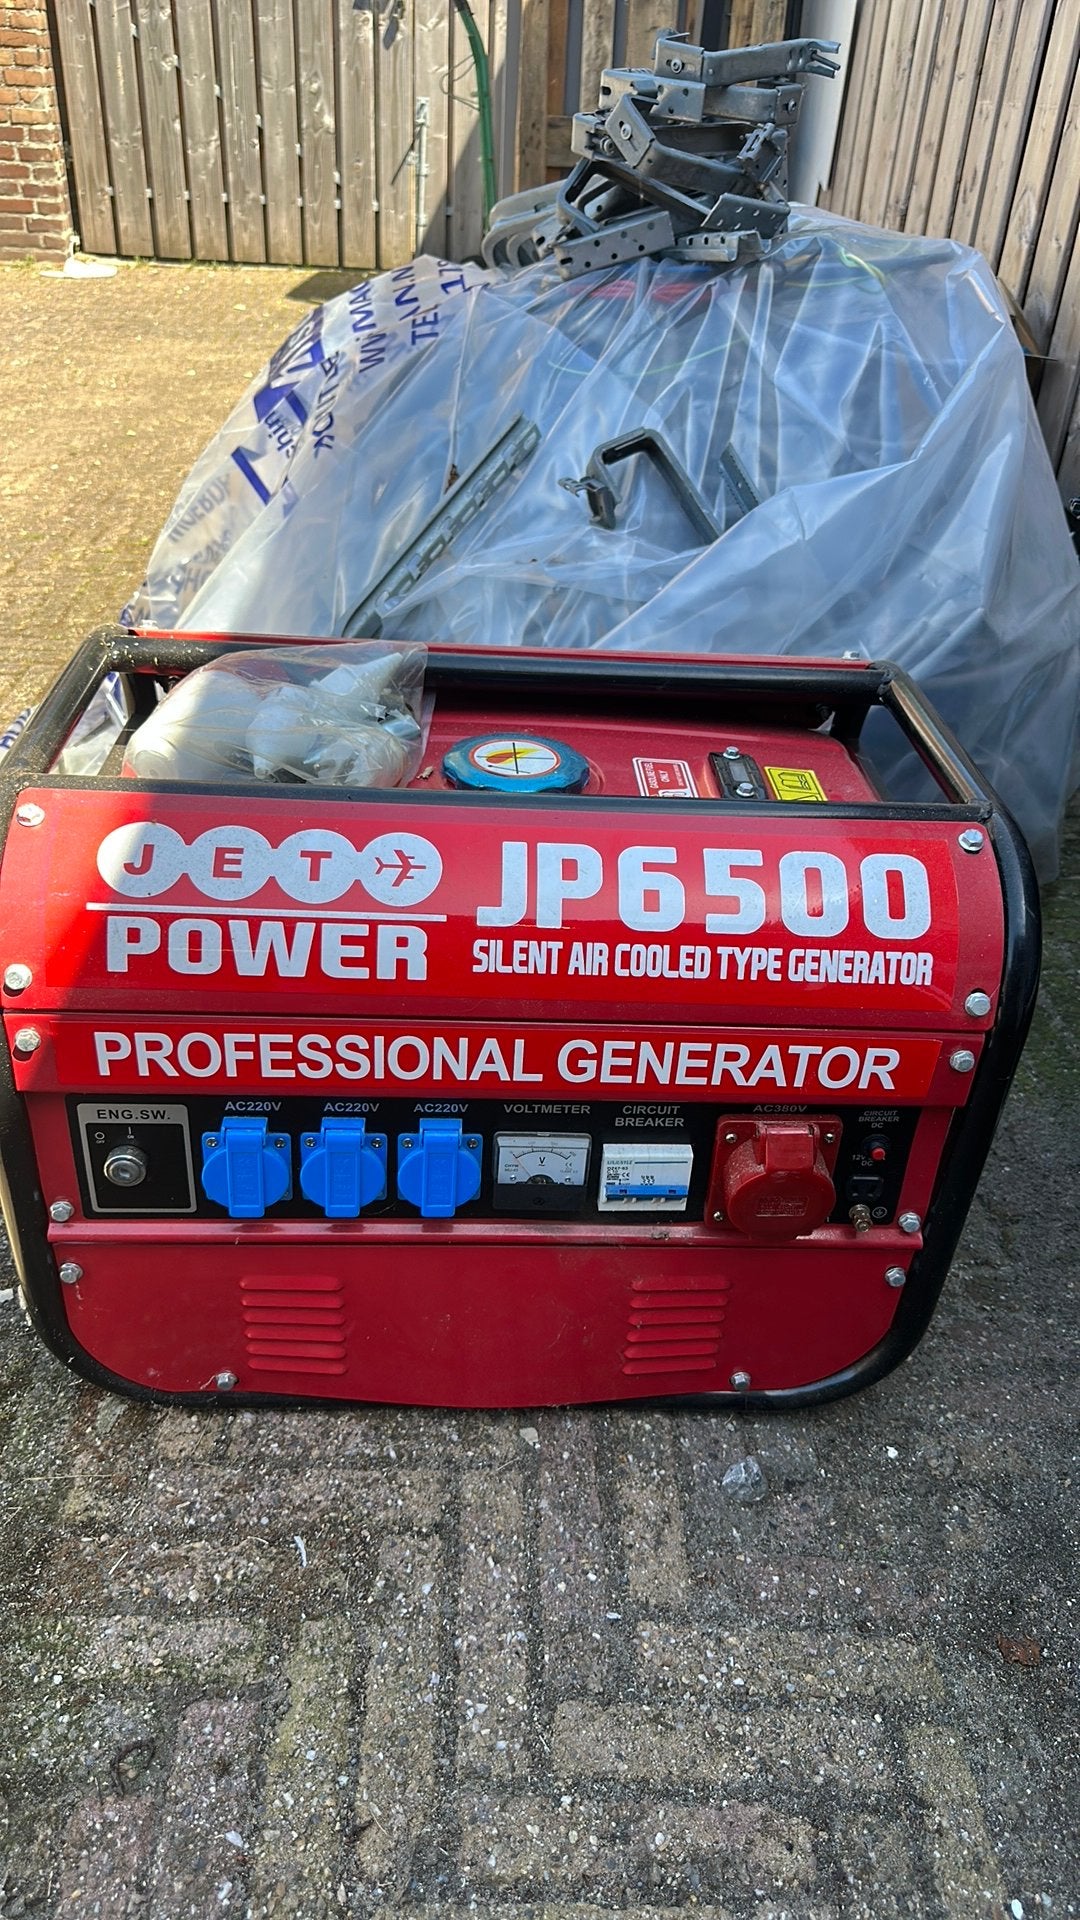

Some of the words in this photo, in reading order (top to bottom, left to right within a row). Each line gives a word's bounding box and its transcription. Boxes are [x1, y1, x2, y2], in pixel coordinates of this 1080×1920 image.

[476, 840, 932, 940] JP6500
[106, 915, 428, 980] POWER
[472, 939, 563, 976] SILENT
[568, 942, 608, 977] AIR
[614, 943, 711, 980] COOLED
[717, 946, 783, 983] TYPE
[787, 948, 933, 986] GENERATOR
[94, 1031, 543, 1082] PROFESSIONAL
[557, 1038, 901, 1091] GENERATOR
[224, 1101, 282, 1112] AC220V
[323, 1102, 380, 1113] AC220V
[413, 1103, 469, 1113] AC220V
[503, 1104, 591, 1115] VOLTMETER
[622, 1105, 681, 1115] CIRCUIT
[753, 1105, 808, 1113] AC380V
[96, 1109, 171, 1120] ENG.SW.
[615, 1117, 685, 1127] BREAKER
